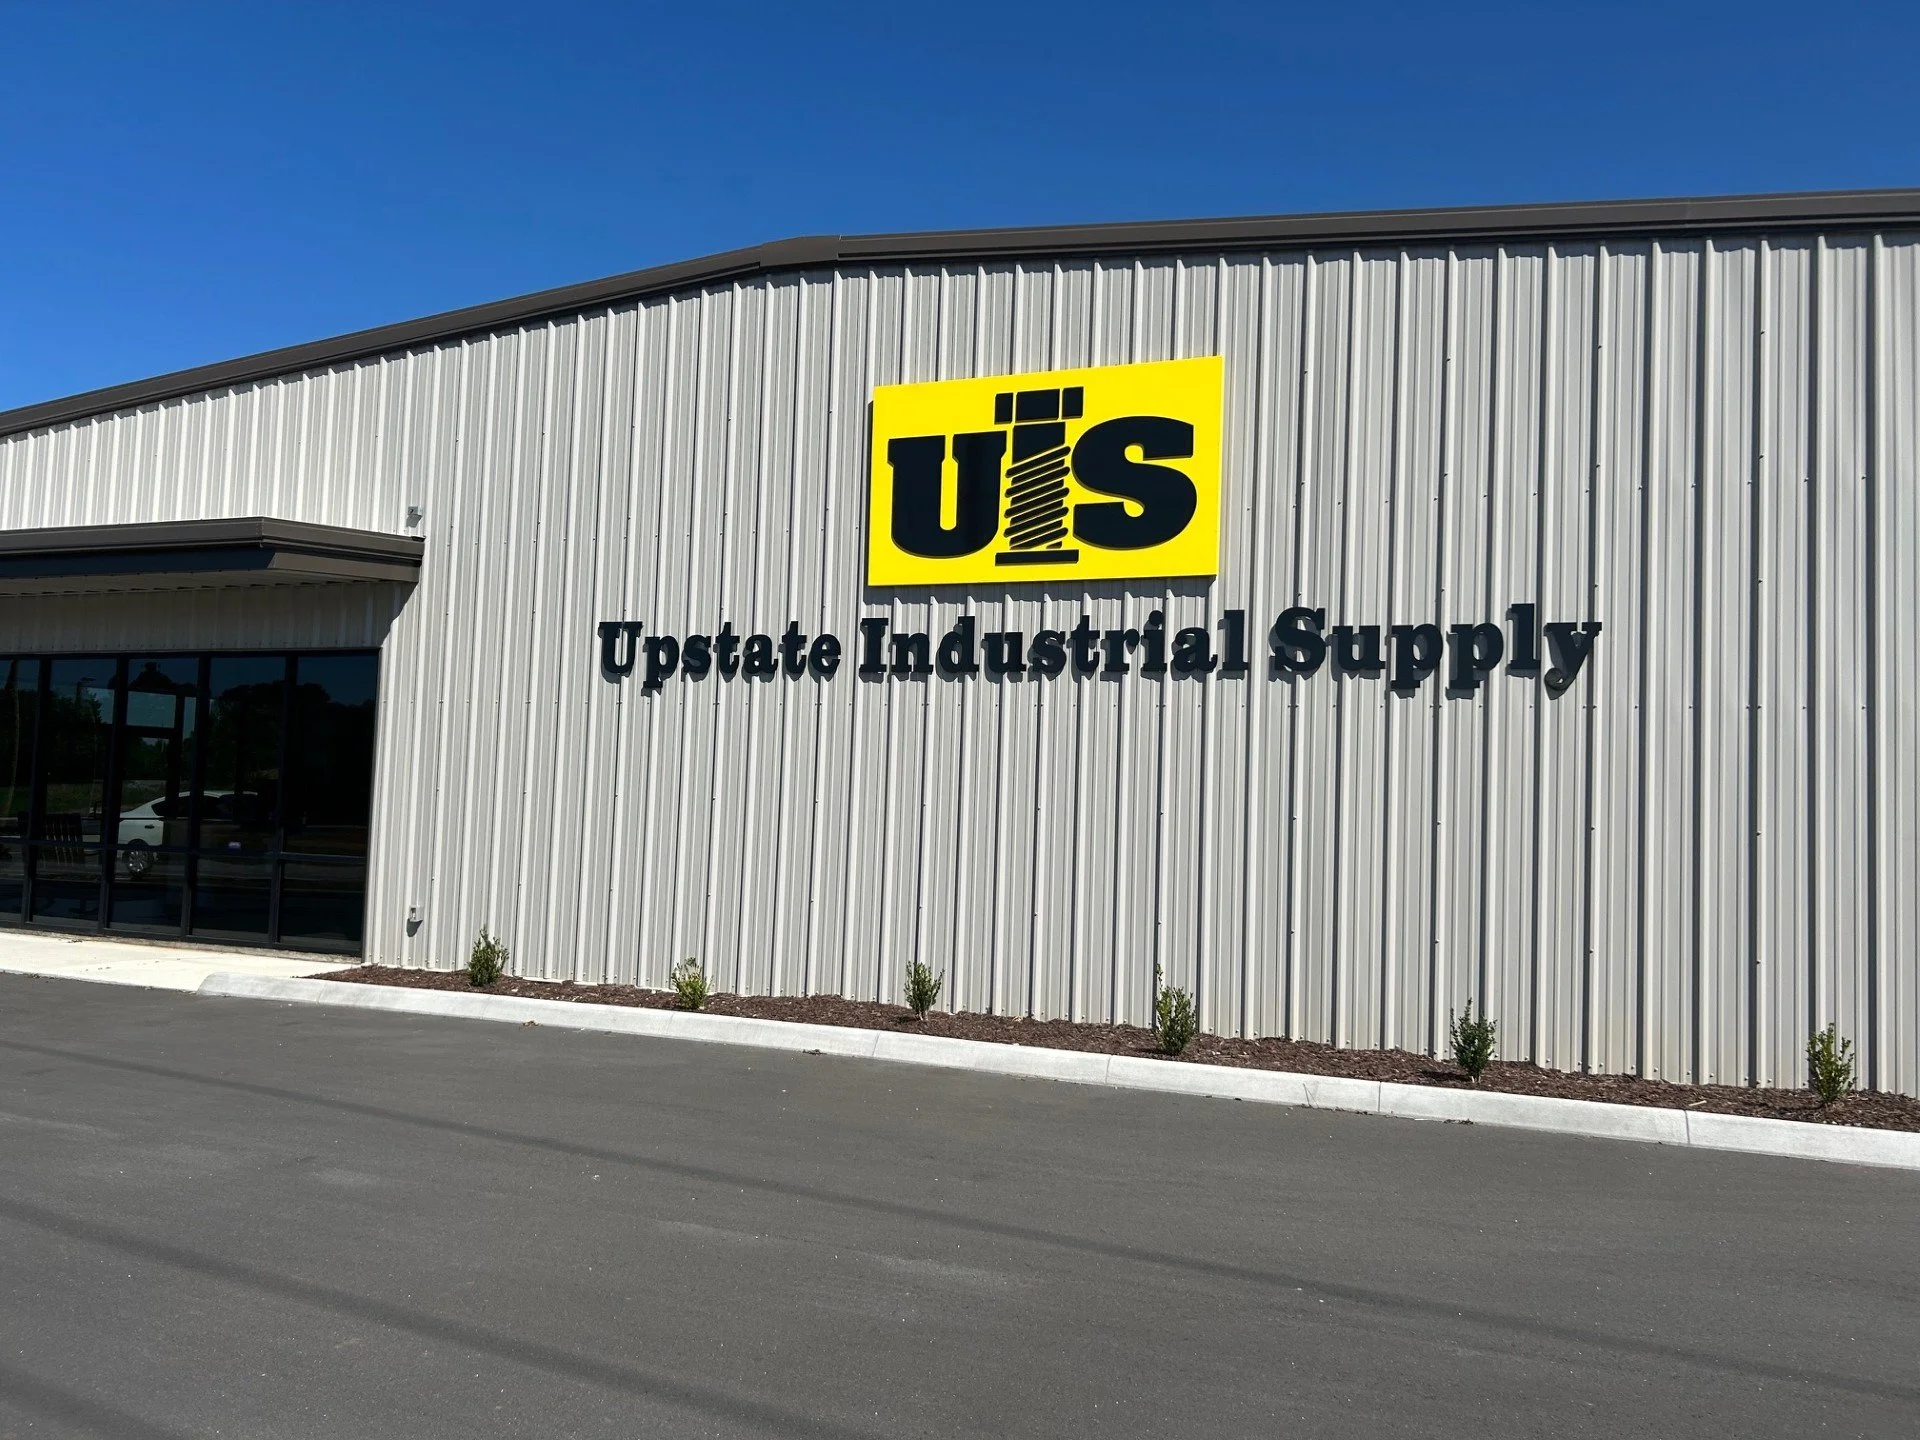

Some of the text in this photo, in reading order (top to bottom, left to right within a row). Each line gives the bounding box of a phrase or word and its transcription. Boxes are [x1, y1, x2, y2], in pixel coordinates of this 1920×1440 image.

[887, 386, 1197, 566] UIS
[599, 603, 1602, 691] Upstate Industrial Supply
